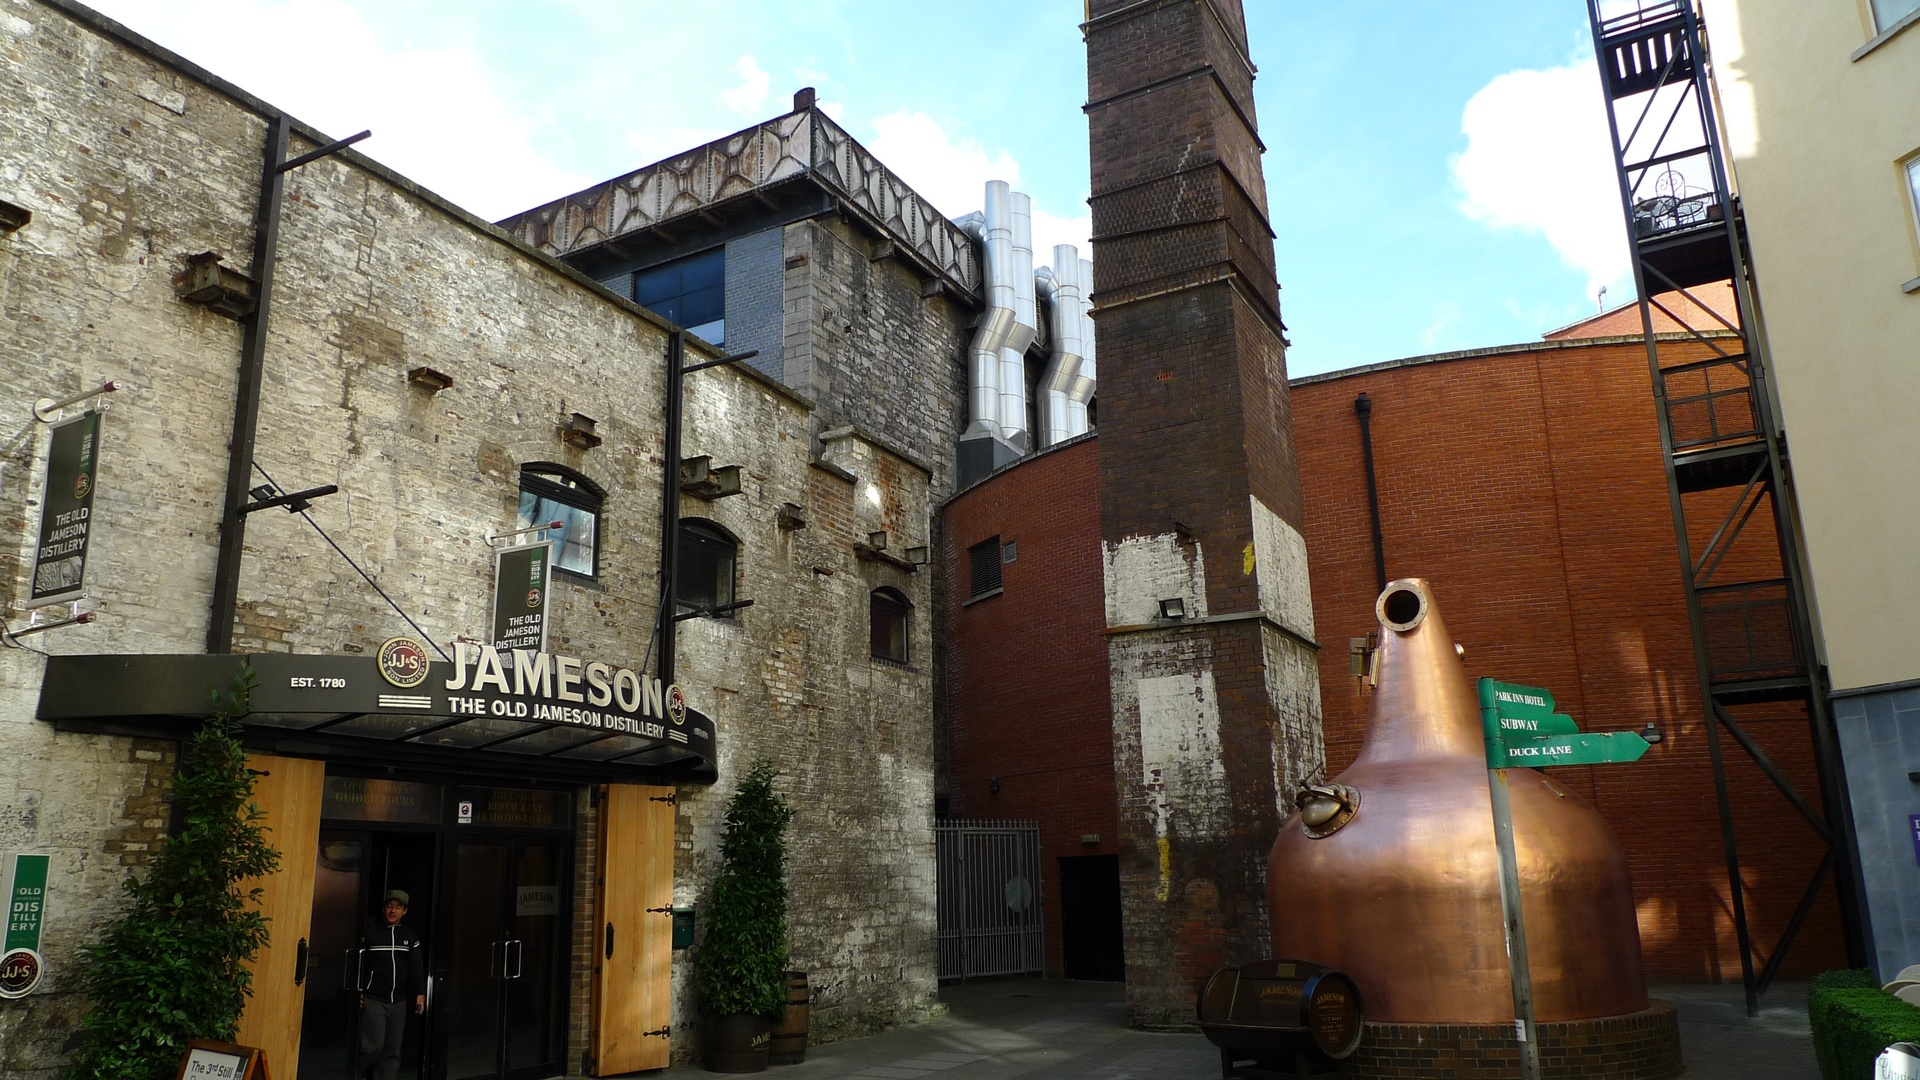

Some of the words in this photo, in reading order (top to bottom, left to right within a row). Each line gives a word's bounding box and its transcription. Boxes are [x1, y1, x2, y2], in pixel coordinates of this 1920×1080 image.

[56, 512, 71, 527] THE
[71, 507, 89, 521] OLD
[48, 522, 87, 543] JAMESON
[40, 537, 86, 559] DISTILLERY
[509, 615, 524, 627] THE
[525, 613, 541, 625] OLD
[504, 625, 540, 638] JAMESON
[496, 636, 540, 650] DISTILLERY
[384, 642, 397, 658] JOHN
[399, 640, 426, 662] JAMESON
[387, 653, 418, 669] JJ&S
[387, 669, 400, 682] SON
[402, 667, 425, 683] LIMITED
[446, 642, 663, 720] JAMESON
[290, 677, 316, 688] EST.
[319, 678, 346, 688] 1780
[1495, 690, 1512, 702] PARK
[1513, 693, 1524, 703] INN
[1524, 695, 1546, 707] HOTEL
[448, 697, 486, 715] THE
[490, 699, 528, 718] OLD
[532, 703, 601, 727] JAMESON
[605, 714, 665, 739] DISTILLERY
[1500, 718, 1538, 731] SUBWAY
[1509, 747, 1540, 757] DUCK
[1542, 745, 1572, 755] LANE
[343, 779, 372, 791] OPEN
[385, 783, 409, 794] DAYS
[335, 792, 377, 804] GUIDED
[380, 795, 415, 806] TOURS
[488, 801, 544, 813] RESTAURANT
[20, 887, 41, 895] OLD
[519, 891, 555, 906] JAMESON
[13, 902, 39, 912] DIS
[13, 913, 37, 921] TILL
[11, 922, 37, 931] ERY
[1260, 985, 1303, 999] JAMESON
[1317, 992, 1345, 1005] JAMESON
[191, 1060, 205, 1074] The
[206, 1063, 219, 1075] 3rd
[217, 1065, 233, 1079] Still
